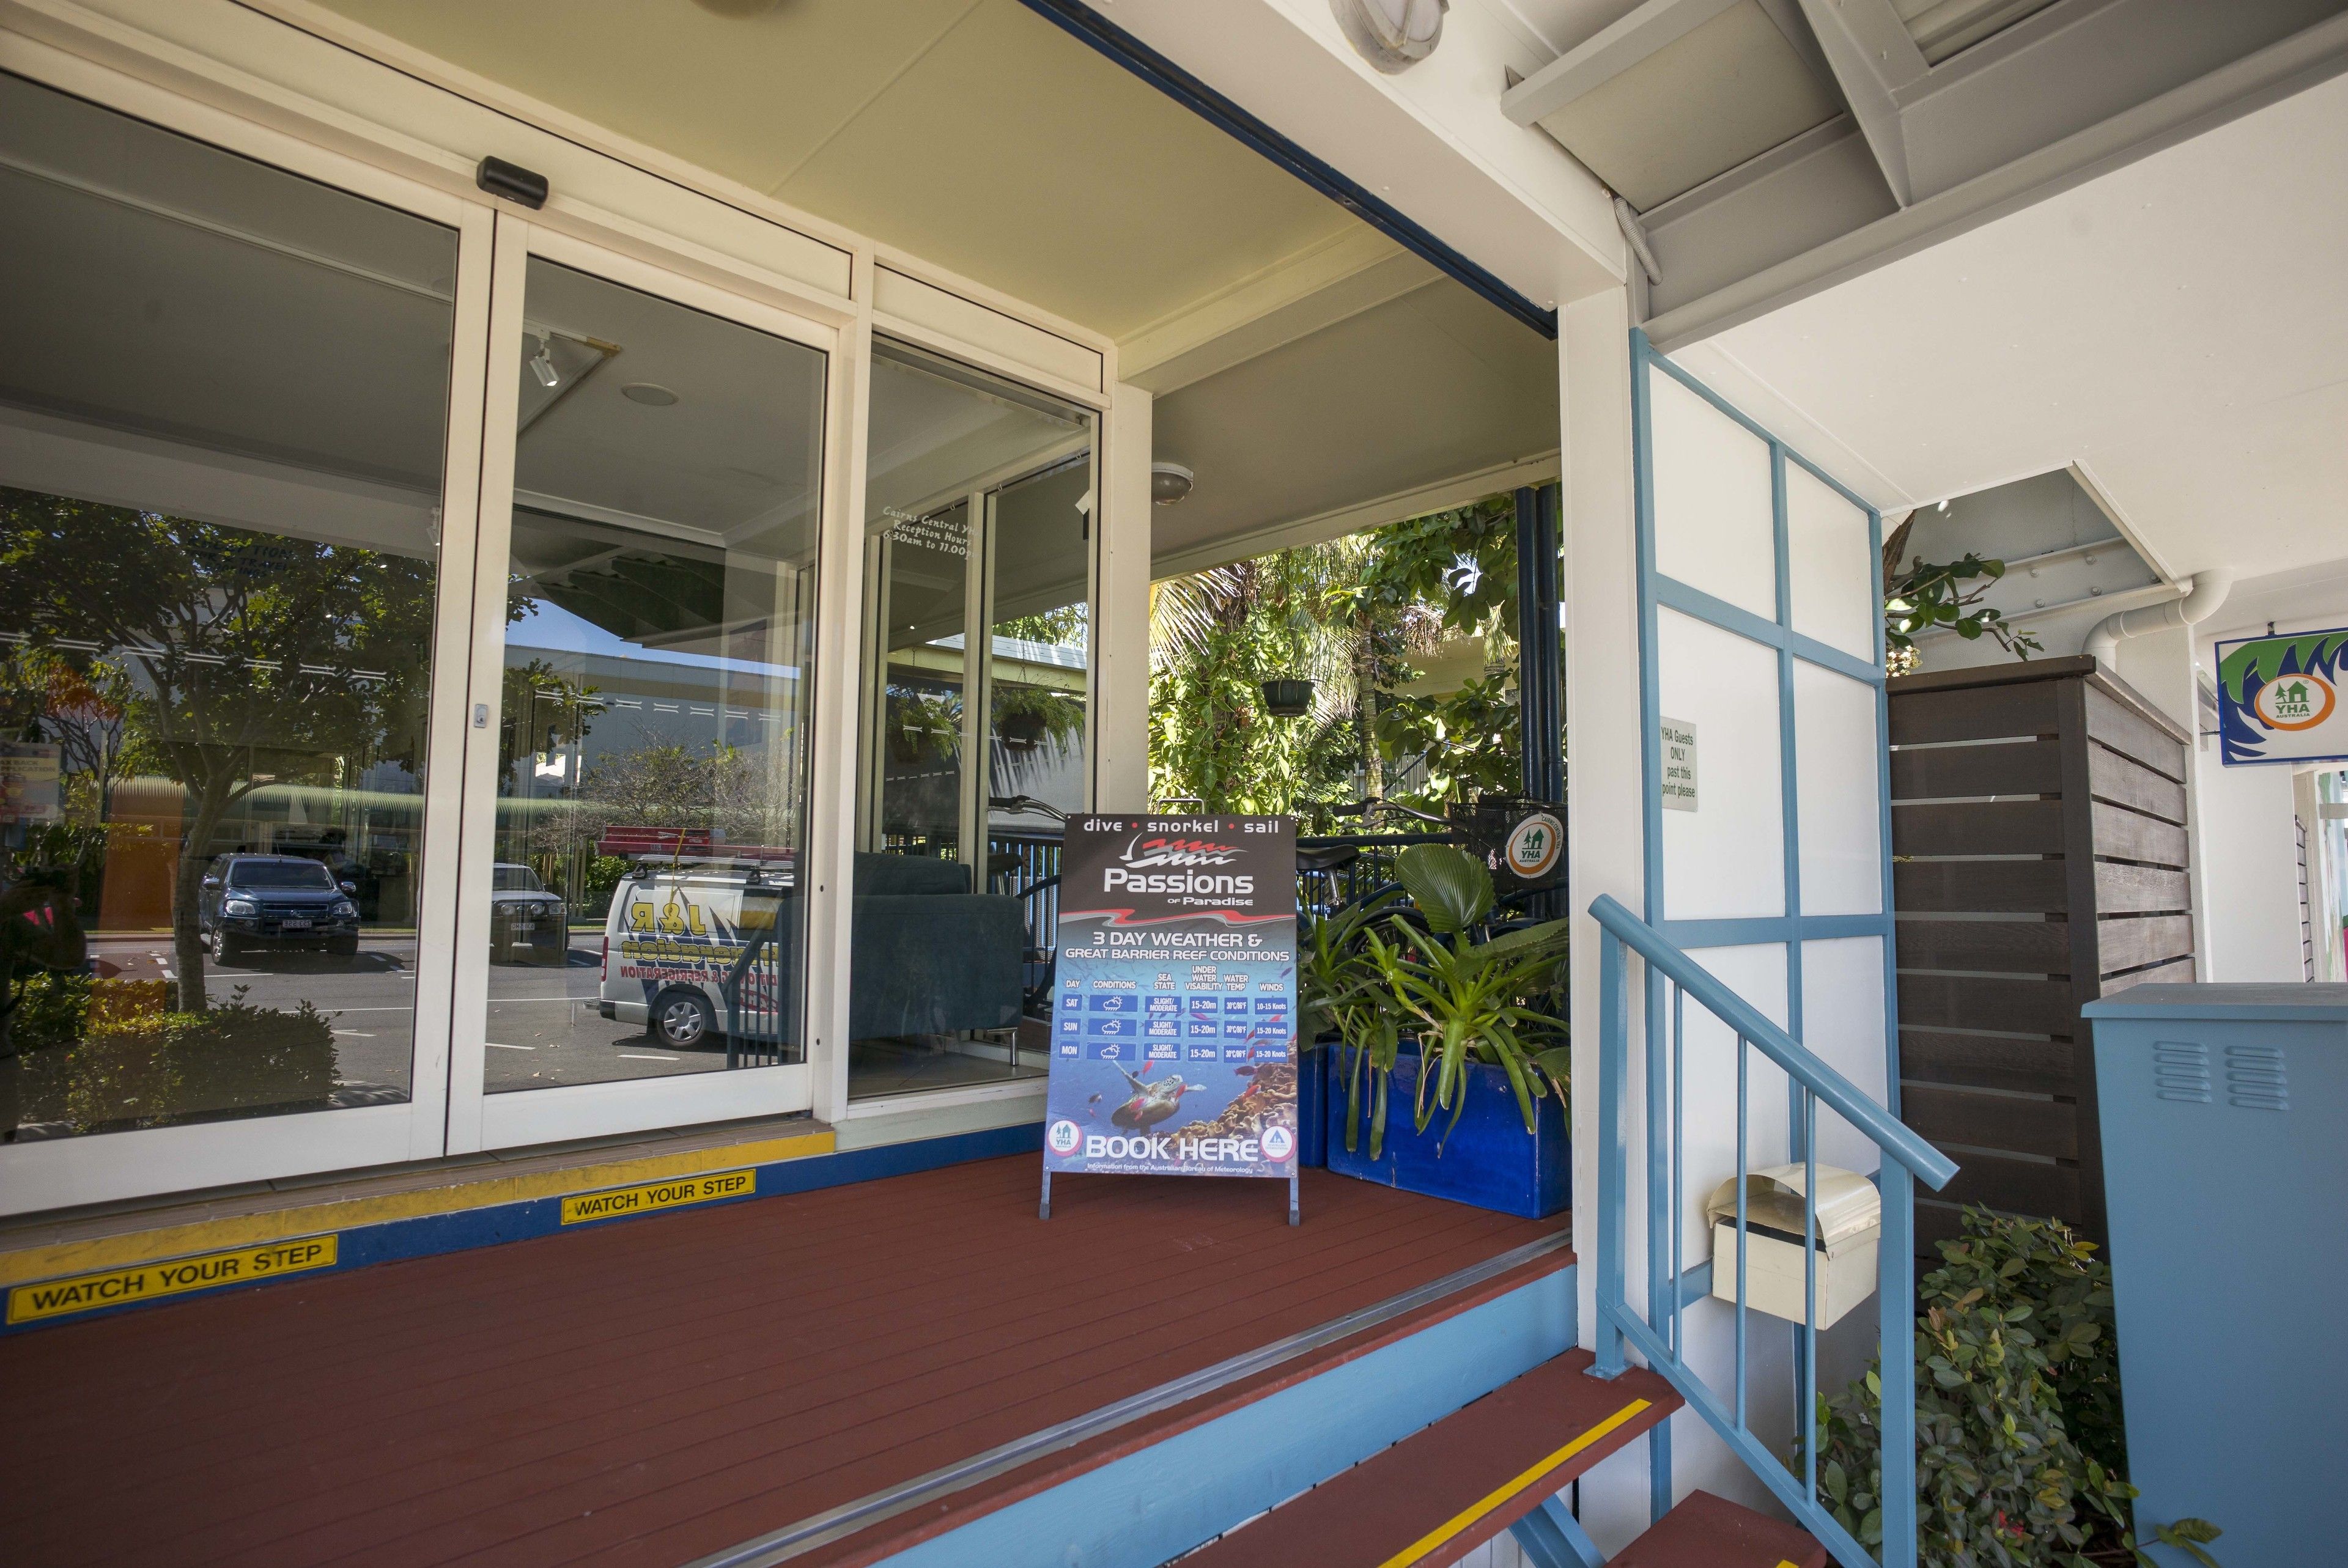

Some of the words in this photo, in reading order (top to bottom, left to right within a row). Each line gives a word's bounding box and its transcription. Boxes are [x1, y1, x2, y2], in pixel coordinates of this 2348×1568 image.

[883, 506, 917, 522] Cairns
[921, 515, 958, 531] Central
[893, 520, 941, 539] Reception
[945, 532, 972, 546] Hours
[927, 540, 935, 549] to
[2275, 704, 2309, 714] YHA
[1661, 726, 1673, 742] YHA
[1675, 730, 1693, 745] Guests
[1671, 747, 1685, 761] ONLY
[1667, 766, 1679, 779] past
[1681, 767, 1691, 779] this
[1663, 782, 1676, 797] point
[1678, 784, 1695, 798] please
[1084, 819, 1122, 831] dive
[1147, 820, 1218, 833] snorkel
[1244, 820, 1279, 833] sail
[1104, 868, 1254, 894] Passions
[1183, 896, 1253, 905] Paradise
[1093, 931, 1106, 945] 3
[1110, 932, 1147, 946] DAY
[1151, 932, 1243, 947] WEATHER
[1247, 933, 1263, 947] &
[1065, 948, 1109, 959] GREAT
[1112, 949, 1170, 960] BARRIER
[1173, 950, 1207, 960] REEF
[1210, 951, 1290, 961] CONDITIONS
[1224, 974, 1249, 983] WATER
[1066, 980, 1080, 988] DAY
[1093, 981, 1136, 989] CONDITIONS
[1185, 982, 1223, 990] VISABILITY
[1259, 983, 1283, 992] WINDS
[1066, 998, 1078, 1007] SAT
[1192, 1001, 1216, 1009] 15-20m
[1063, 1022, 1077, 1031] SUN
[1191, 1025, 1216, 1034] 15-20m
[1061, 1046, 1077, 1055] MON
[1191, 1049, 1215, 1058] 15-20m
[1086, 1135, 1171, 1160] BOOK
[1180, 1138, 1258, 1161] HERE
[574, 1193, 638, 1216] WATCH
[646, 1184, 695, 1204] YOUR
[703, 1176, 746, 1194] STEP
[33, 1274, 144, 1311] WATCH
[160, 1258, 239, 1286] YOUR
[253, 1244, 322, 1272] STEP
